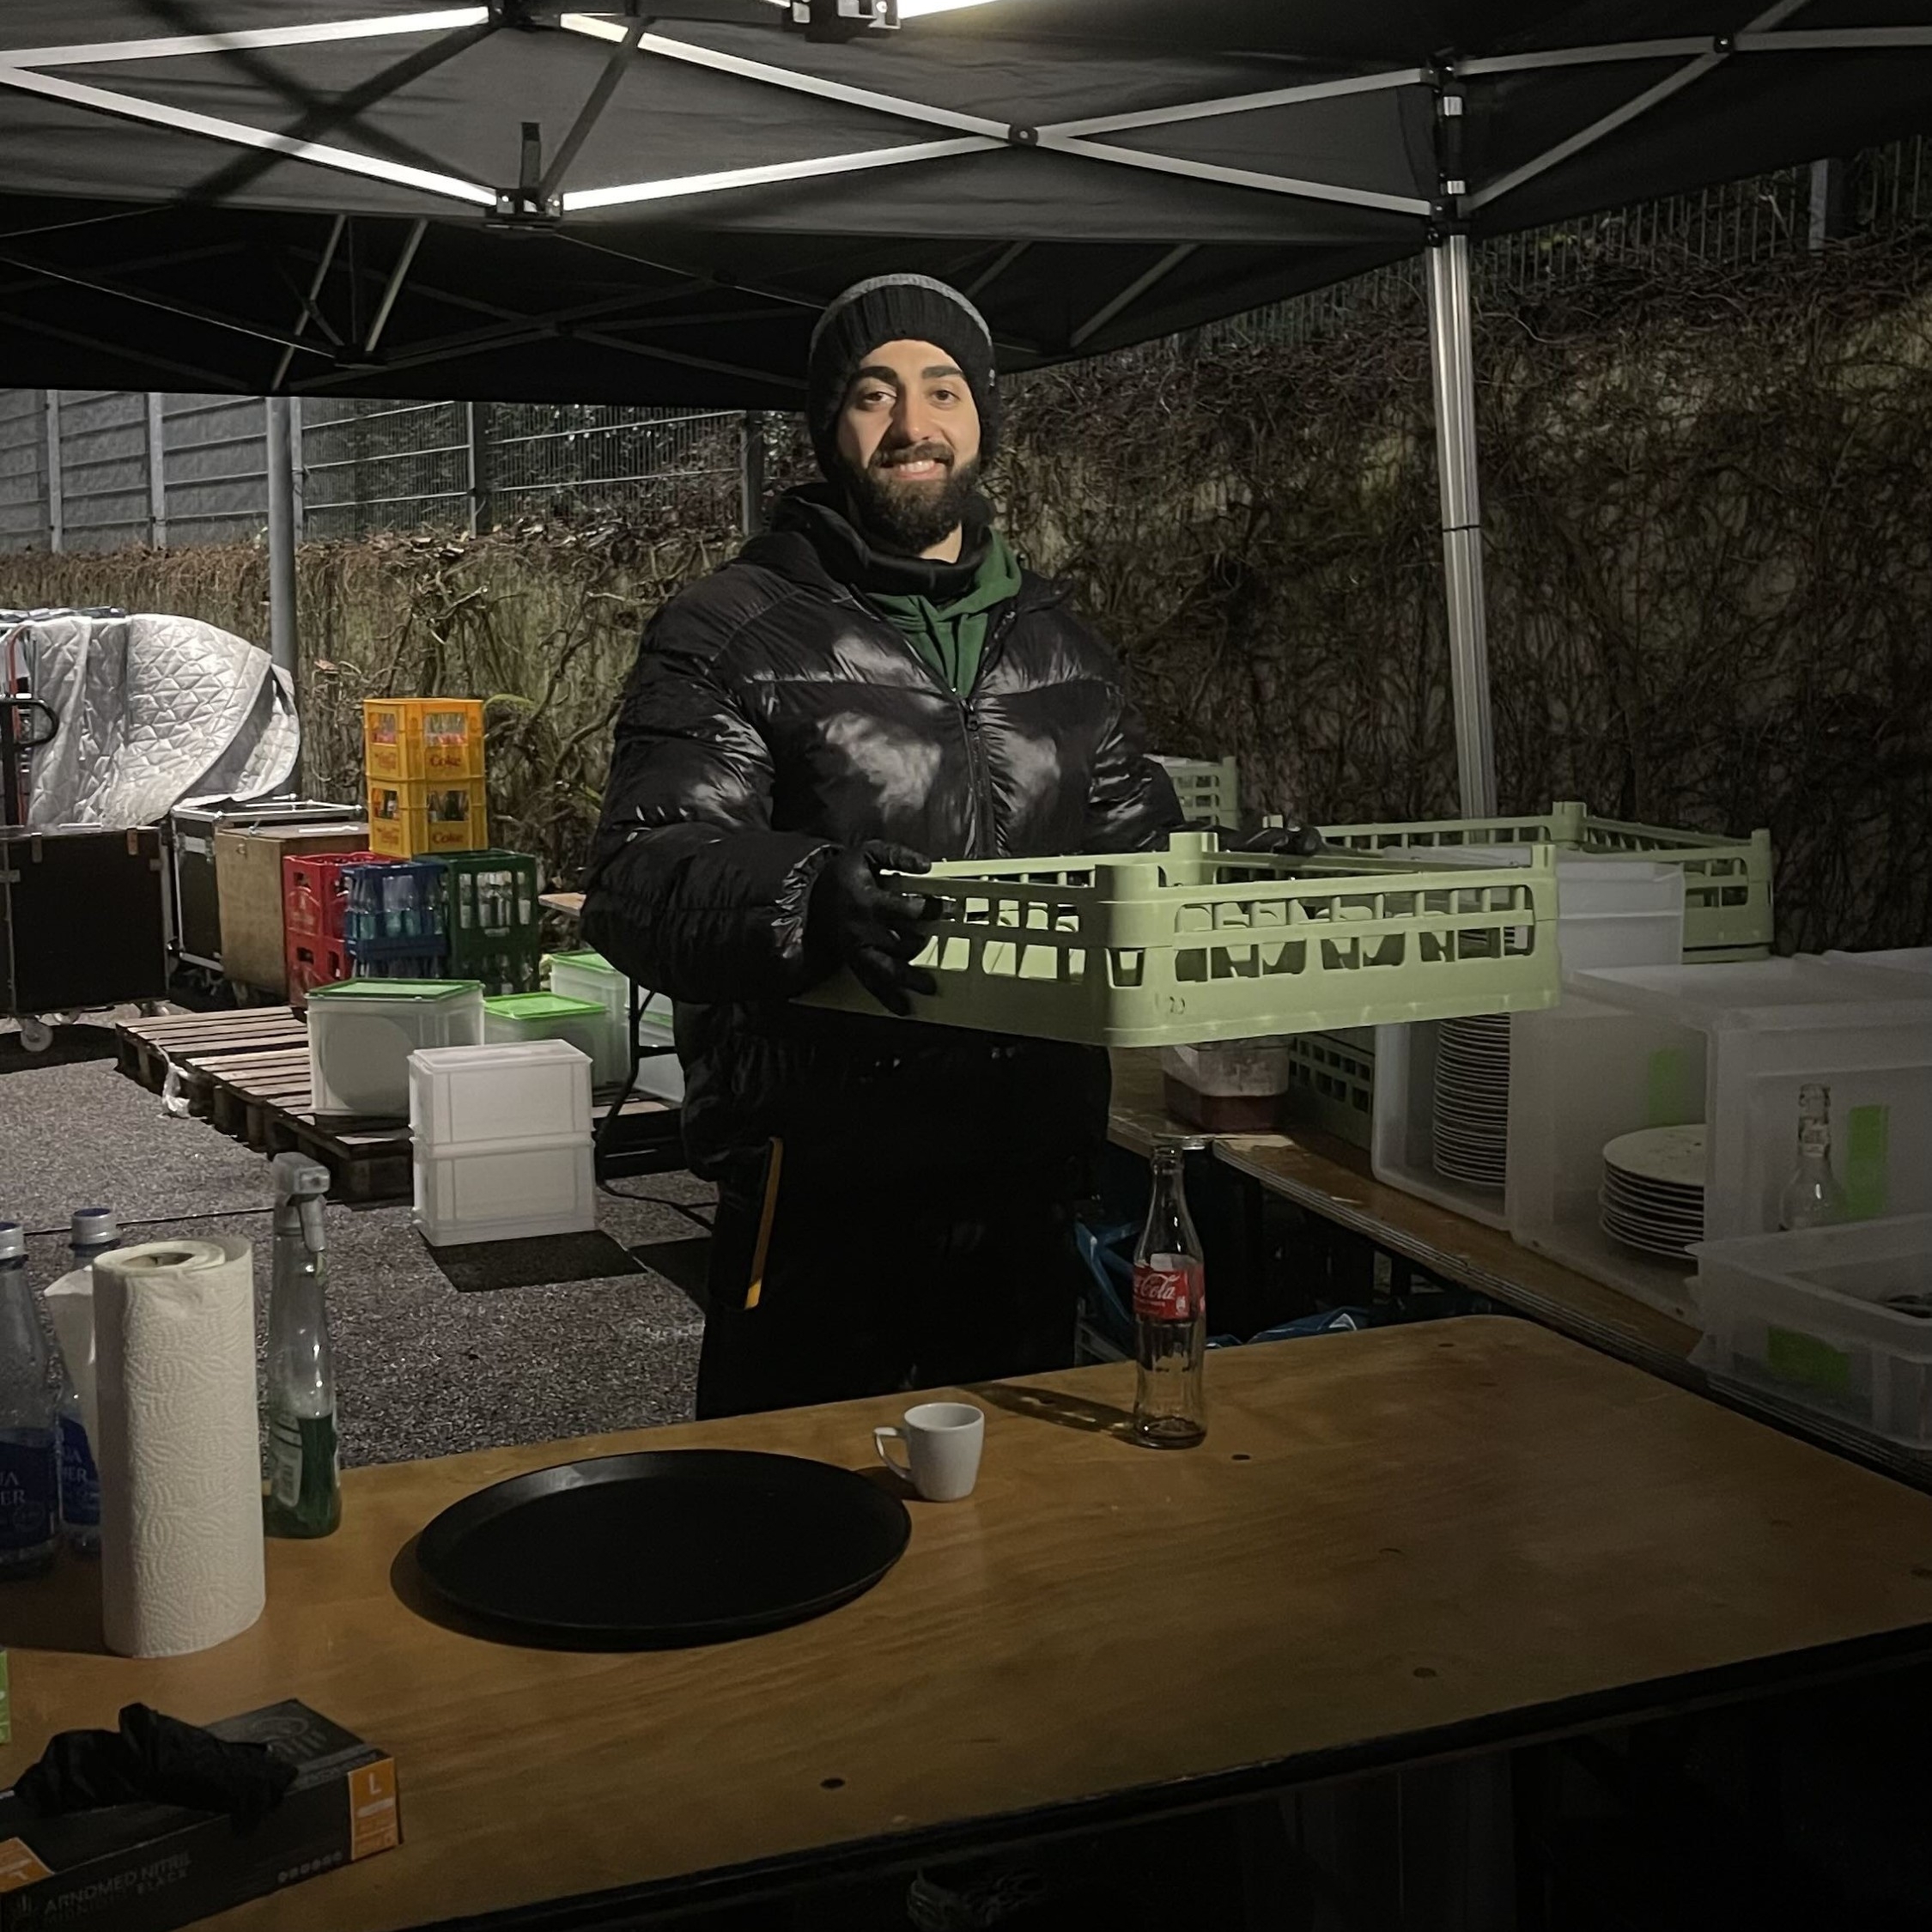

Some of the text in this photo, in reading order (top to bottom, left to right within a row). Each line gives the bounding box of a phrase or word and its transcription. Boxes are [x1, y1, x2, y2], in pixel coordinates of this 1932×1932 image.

[429, 754, 461, 768] Coke
[433, 831, 464, 845] Coke
[1136, 1273, 1182, 1300] Cola
[0, 1490, 26, 1505] ER
[368, 1771, 382, 1795] L
